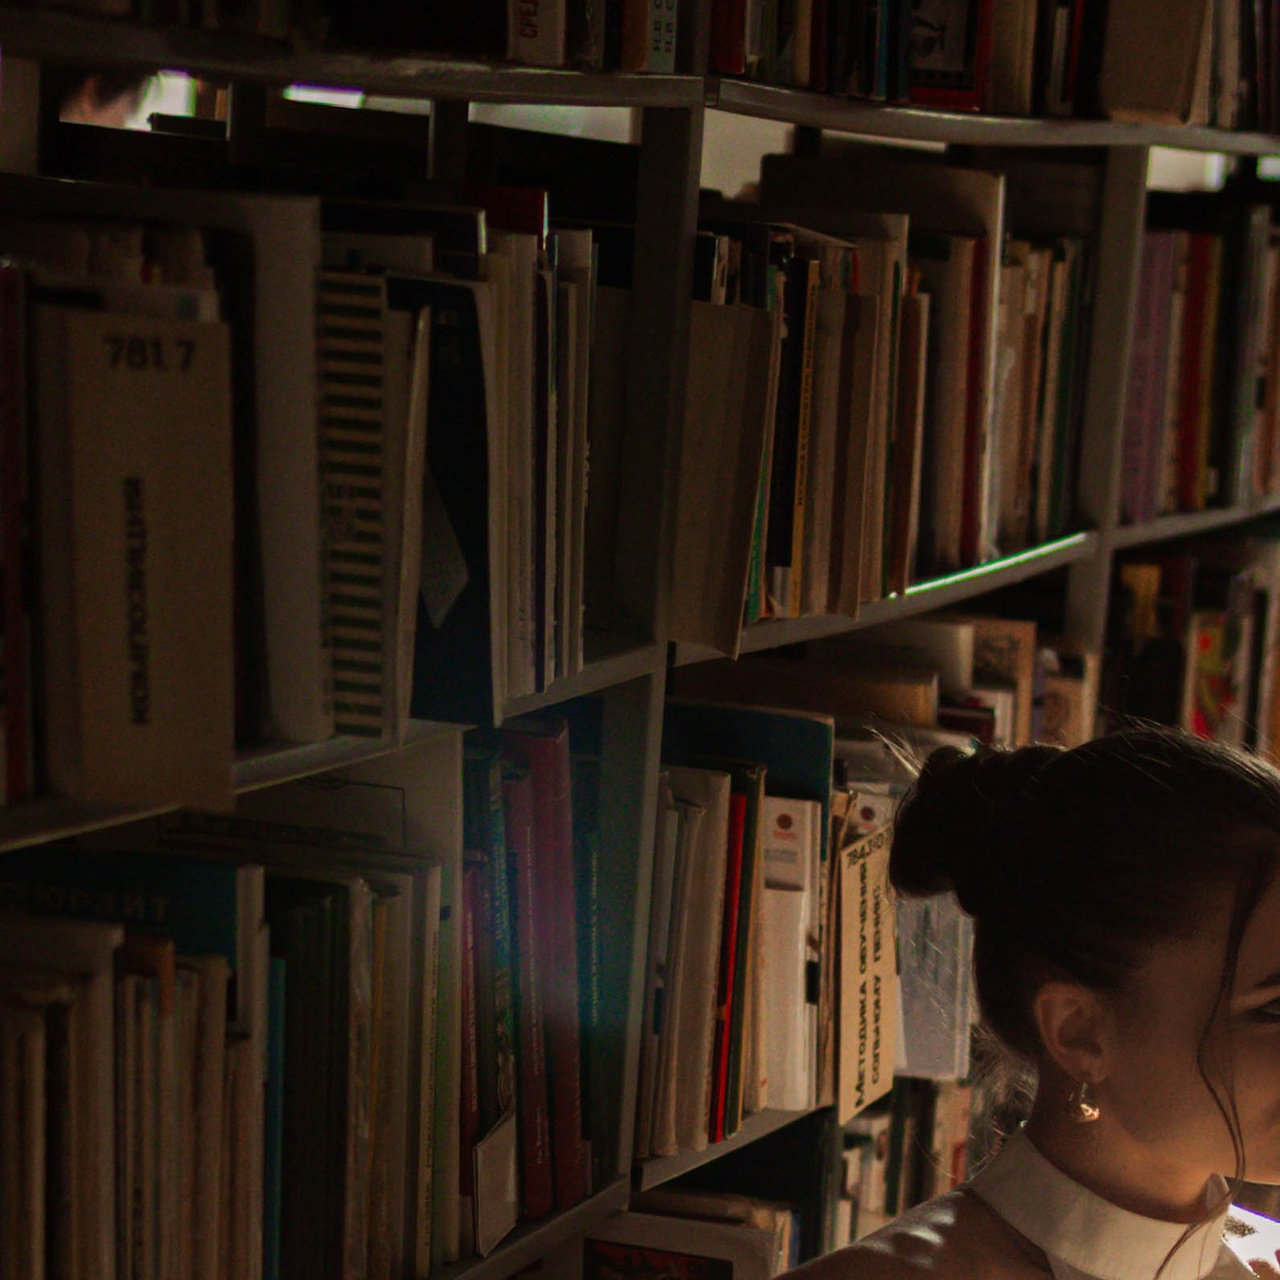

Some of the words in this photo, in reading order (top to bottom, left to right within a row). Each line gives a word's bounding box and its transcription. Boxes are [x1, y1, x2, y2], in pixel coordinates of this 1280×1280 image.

[122, 477, 150, 726] КОМПОЗИЦИЯ
[858, 861, 868, 975] ОБУЧЕНИЯ
[871, 975, 881, 1085] СОЛЬНОМУ
